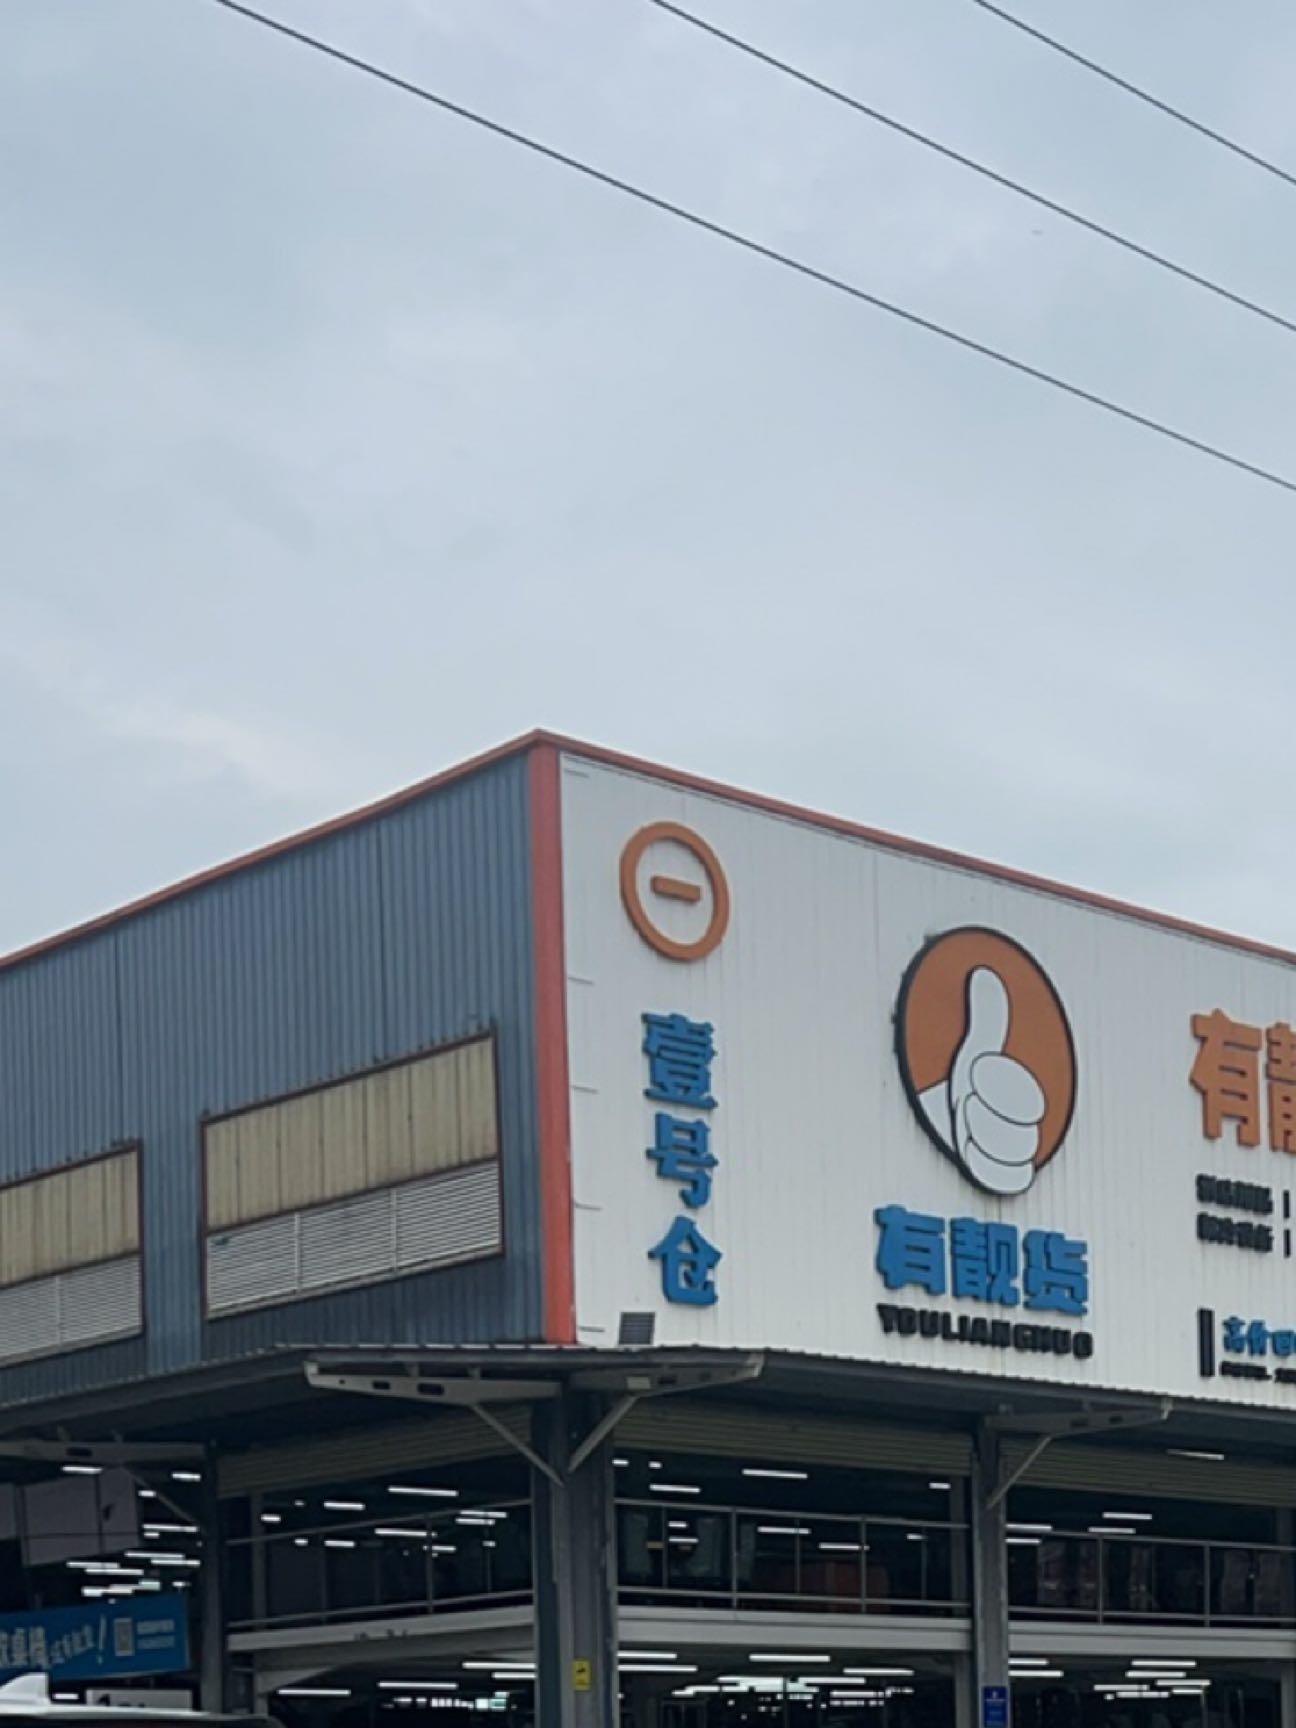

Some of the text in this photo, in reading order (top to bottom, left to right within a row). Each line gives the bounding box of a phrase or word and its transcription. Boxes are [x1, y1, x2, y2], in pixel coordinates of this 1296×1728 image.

[641, 1012, 722, 1306] 壹号仓
[873, 1204, 1089, 1316] 有靓货
[876, 1302, 1094, 1360] YOULIANGHUO
